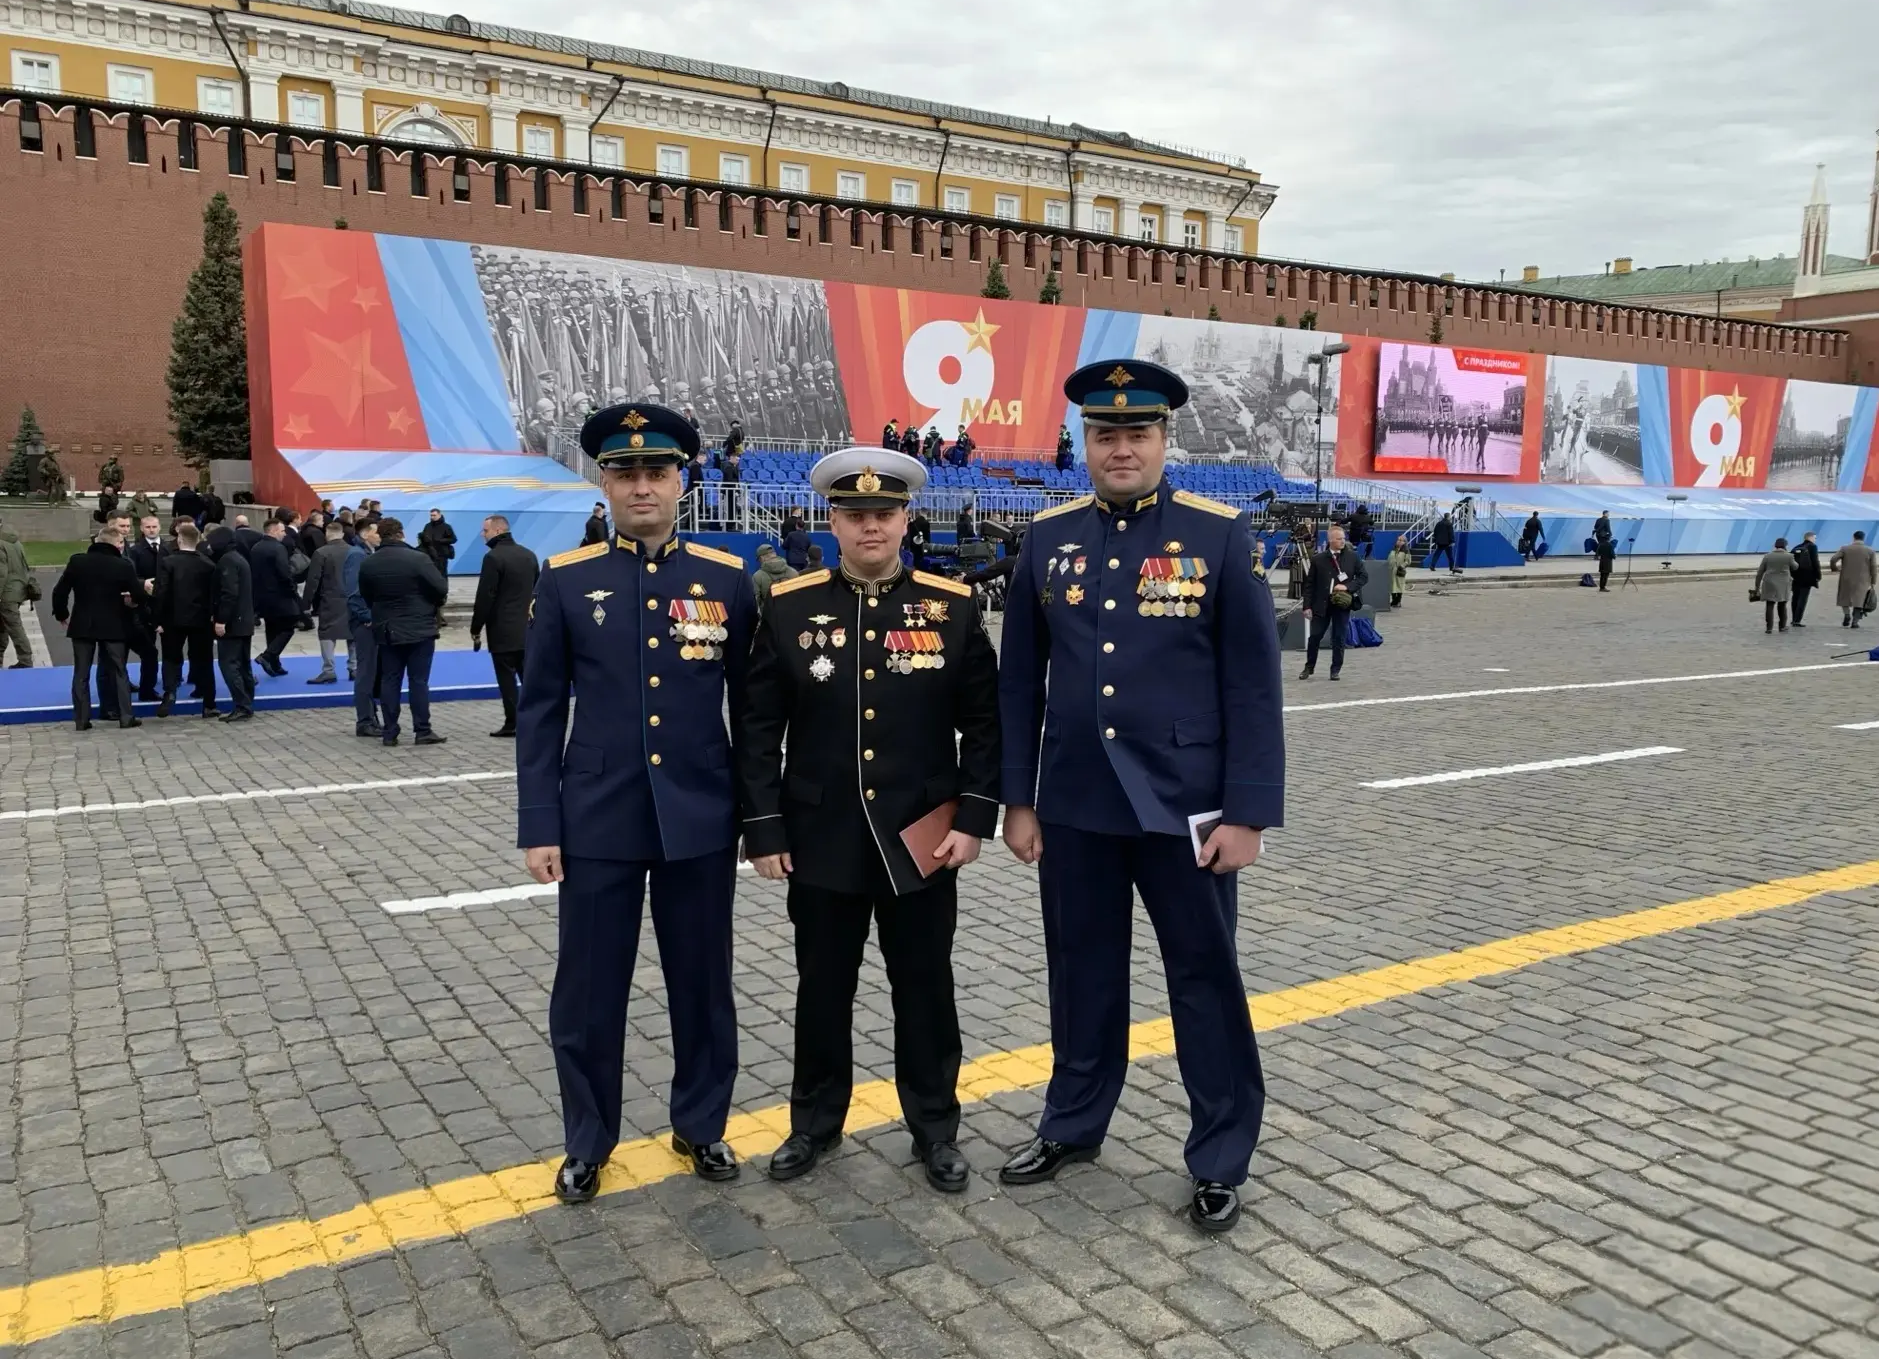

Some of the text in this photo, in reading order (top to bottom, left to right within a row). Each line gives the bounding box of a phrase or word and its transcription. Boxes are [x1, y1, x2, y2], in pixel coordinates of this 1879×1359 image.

[903, 320, 1023, 441] 9 МАЯ
[1464, 357, 1520, 369] С ПРАЗДНИКОМ!
[1690, 394, 1755, 488] 9 МАЯ
